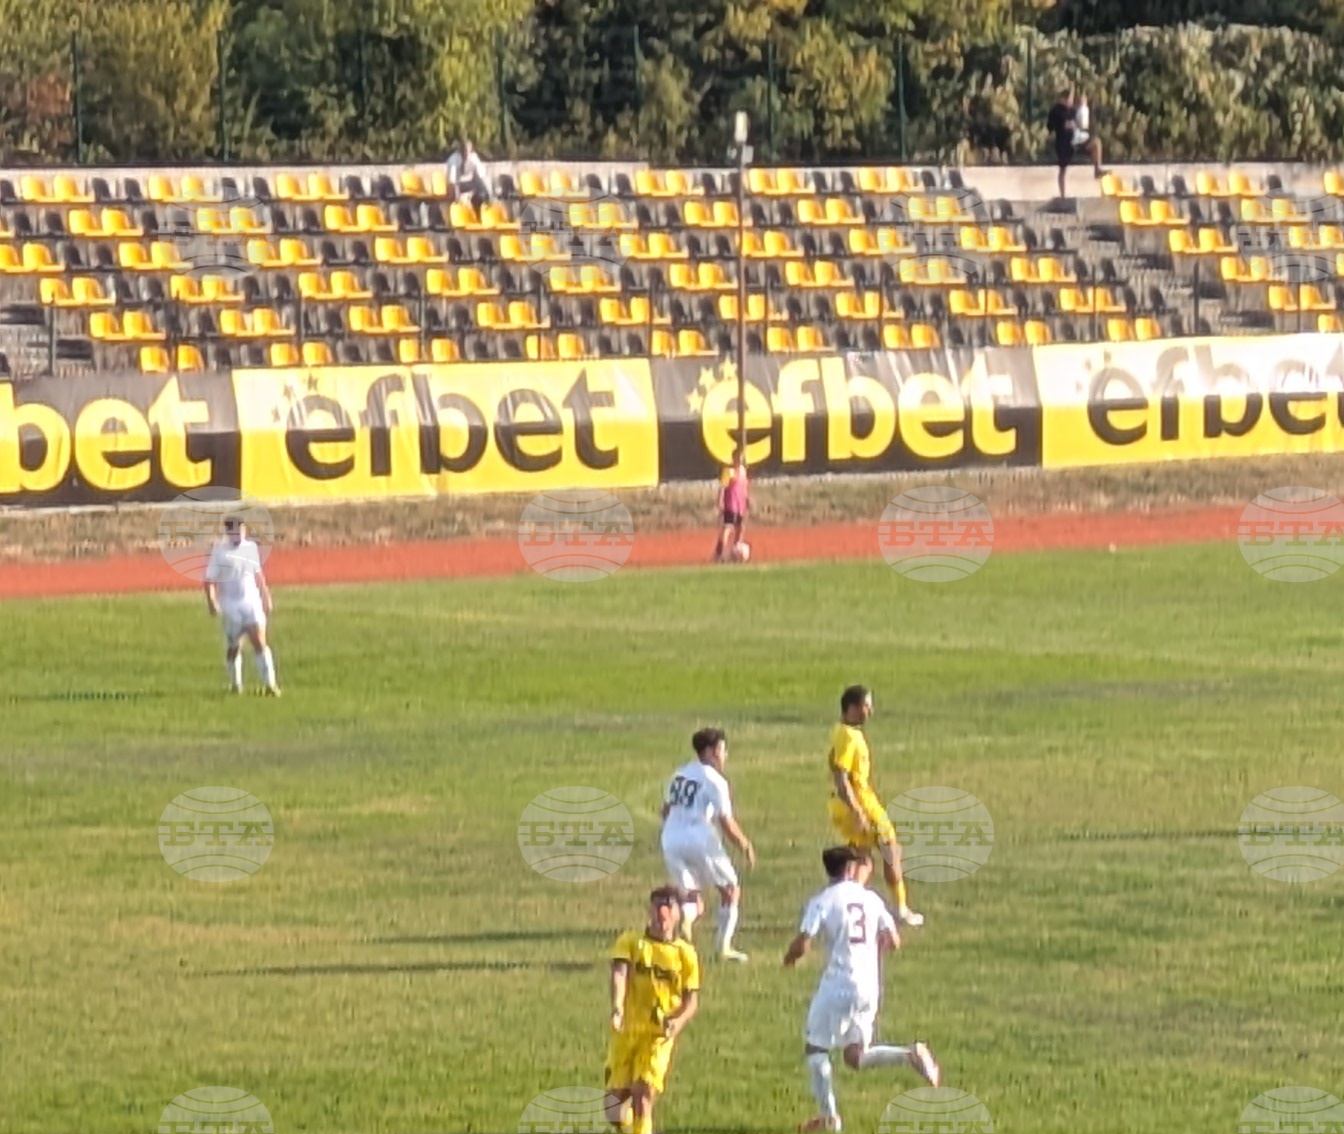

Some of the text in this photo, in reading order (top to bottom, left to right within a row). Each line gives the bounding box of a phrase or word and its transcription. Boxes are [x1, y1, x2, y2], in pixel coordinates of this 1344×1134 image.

[285, 368, 618, 480] efbet
[702, 354, 1016, 465] efbet
[847, 903, 866, 943] 3
